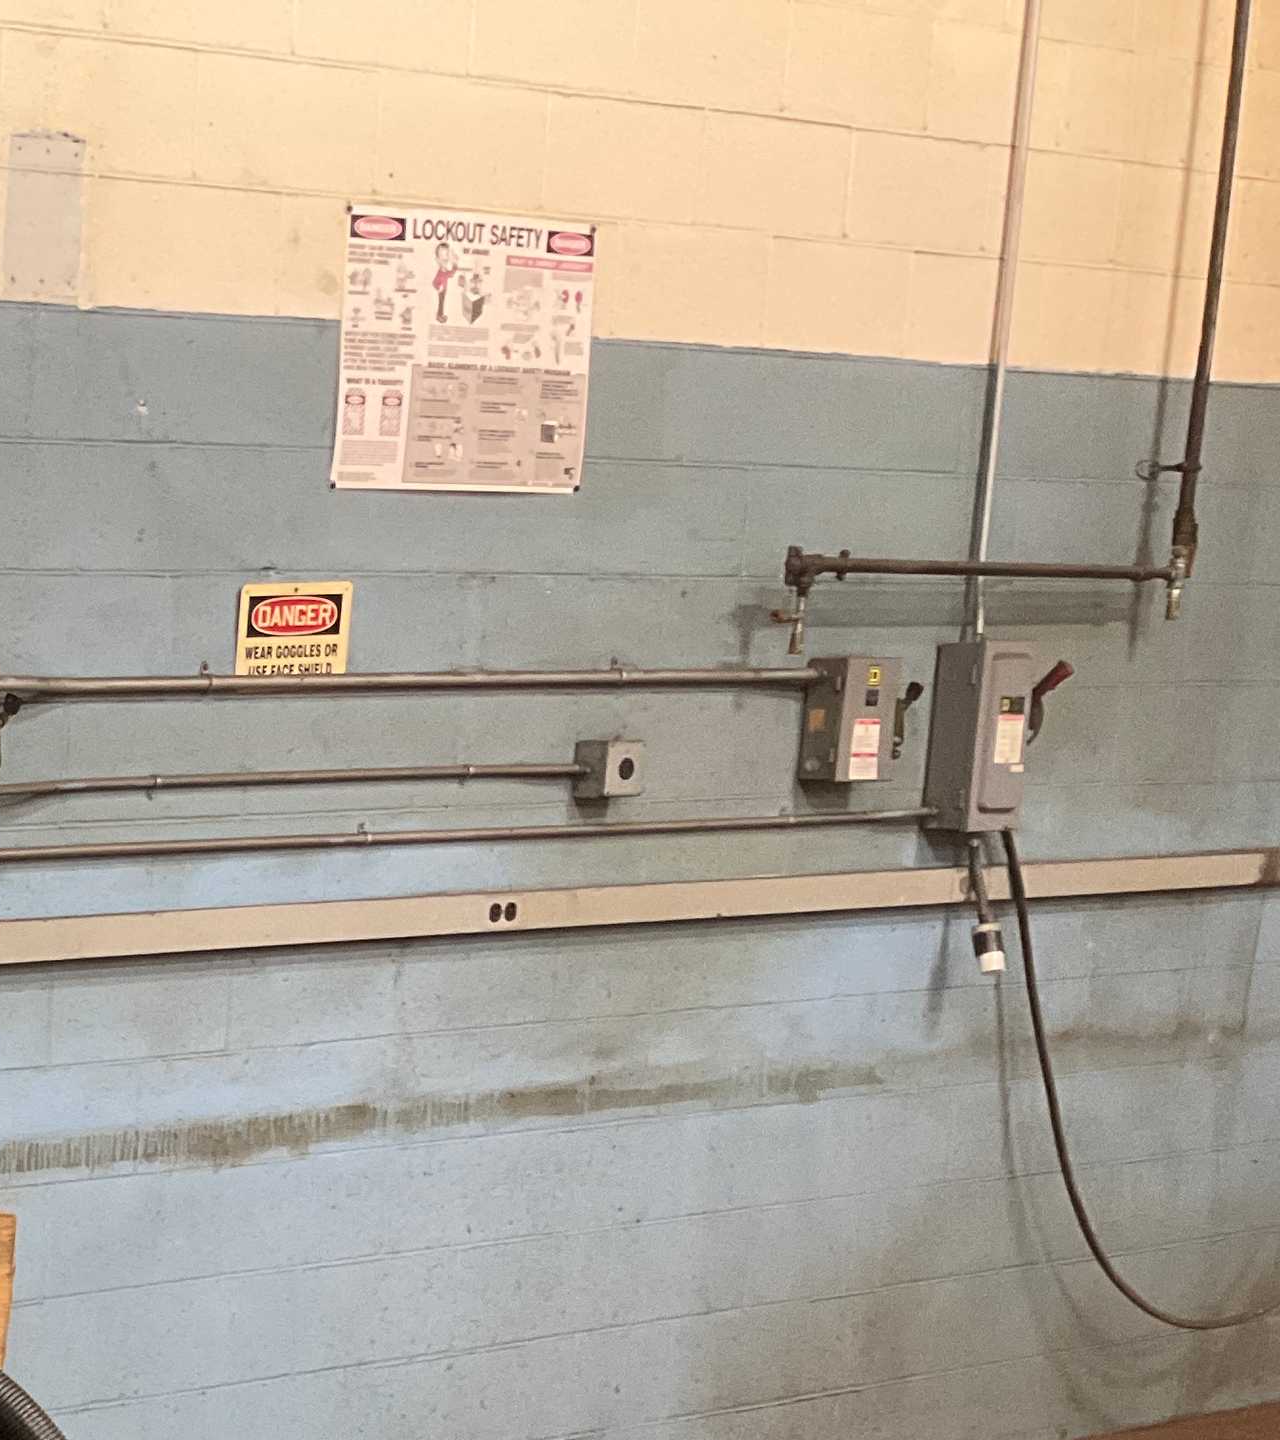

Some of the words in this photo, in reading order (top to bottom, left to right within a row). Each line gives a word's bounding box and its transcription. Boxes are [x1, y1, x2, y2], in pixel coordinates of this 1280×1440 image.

[413, 218, 486, 244] LOCKOUT
[490, 224, 543, 249] SAFETY
[256, 604, 333, 628] DANGER
[245, 645, 273, 660] WEAR
[275, 644, 321, 659] GOGGLES
[324, 643, 338, 657] OR
[248, 665, 268, 676] USE
[271, 664, 295, 676] FACE
[297, 662, 333, 675] SHIELD
